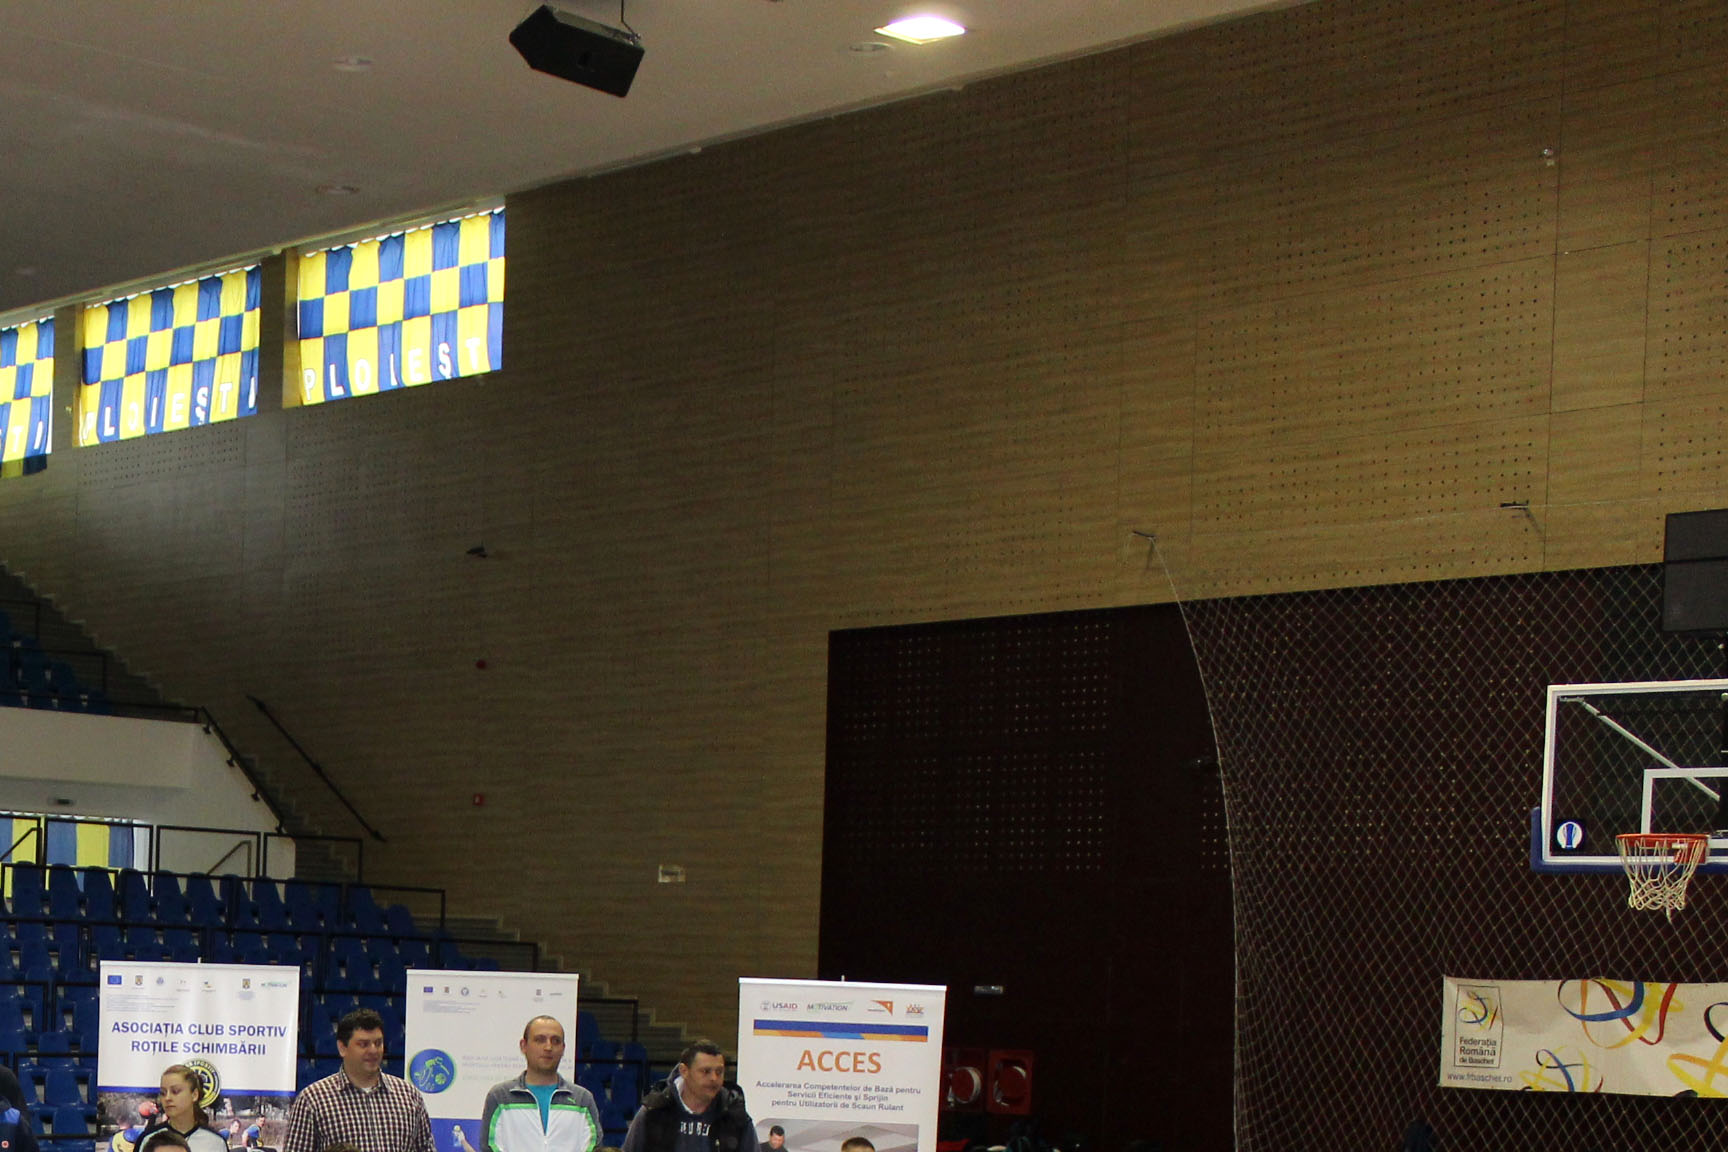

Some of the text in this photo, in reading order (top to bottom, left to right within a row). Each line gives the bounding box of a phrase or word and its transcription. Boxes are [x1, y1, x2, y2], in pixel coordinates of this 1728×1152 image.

[772, 1002, 798, 1010] USAID
[188, 1023, 225, 1036] CLUB
[229, 1024, 287, 1038] SPORTIV
[182, 1040, 266, 1056] SCHIMBĂRII
[796, 1050, 882, 1074] ACCES
[756, 1080, 802, 1090] Accelerarea
[863, 1084, 873, 1092] de
[895, 1087, 921, 1095] pentru
[787, 1090, 816, 1099] Servicii
[818, 1091, 852, 1100] Eficiente
[863, 1094, 889, 1102] Sprijin
[771, 1099, 797, 1108] pentru
[798, 1099, 838, 1108] Utilizatorii
[851, 1102, 876, 1110] Scaun
[878, 1103, 904, 1111] Rulant
